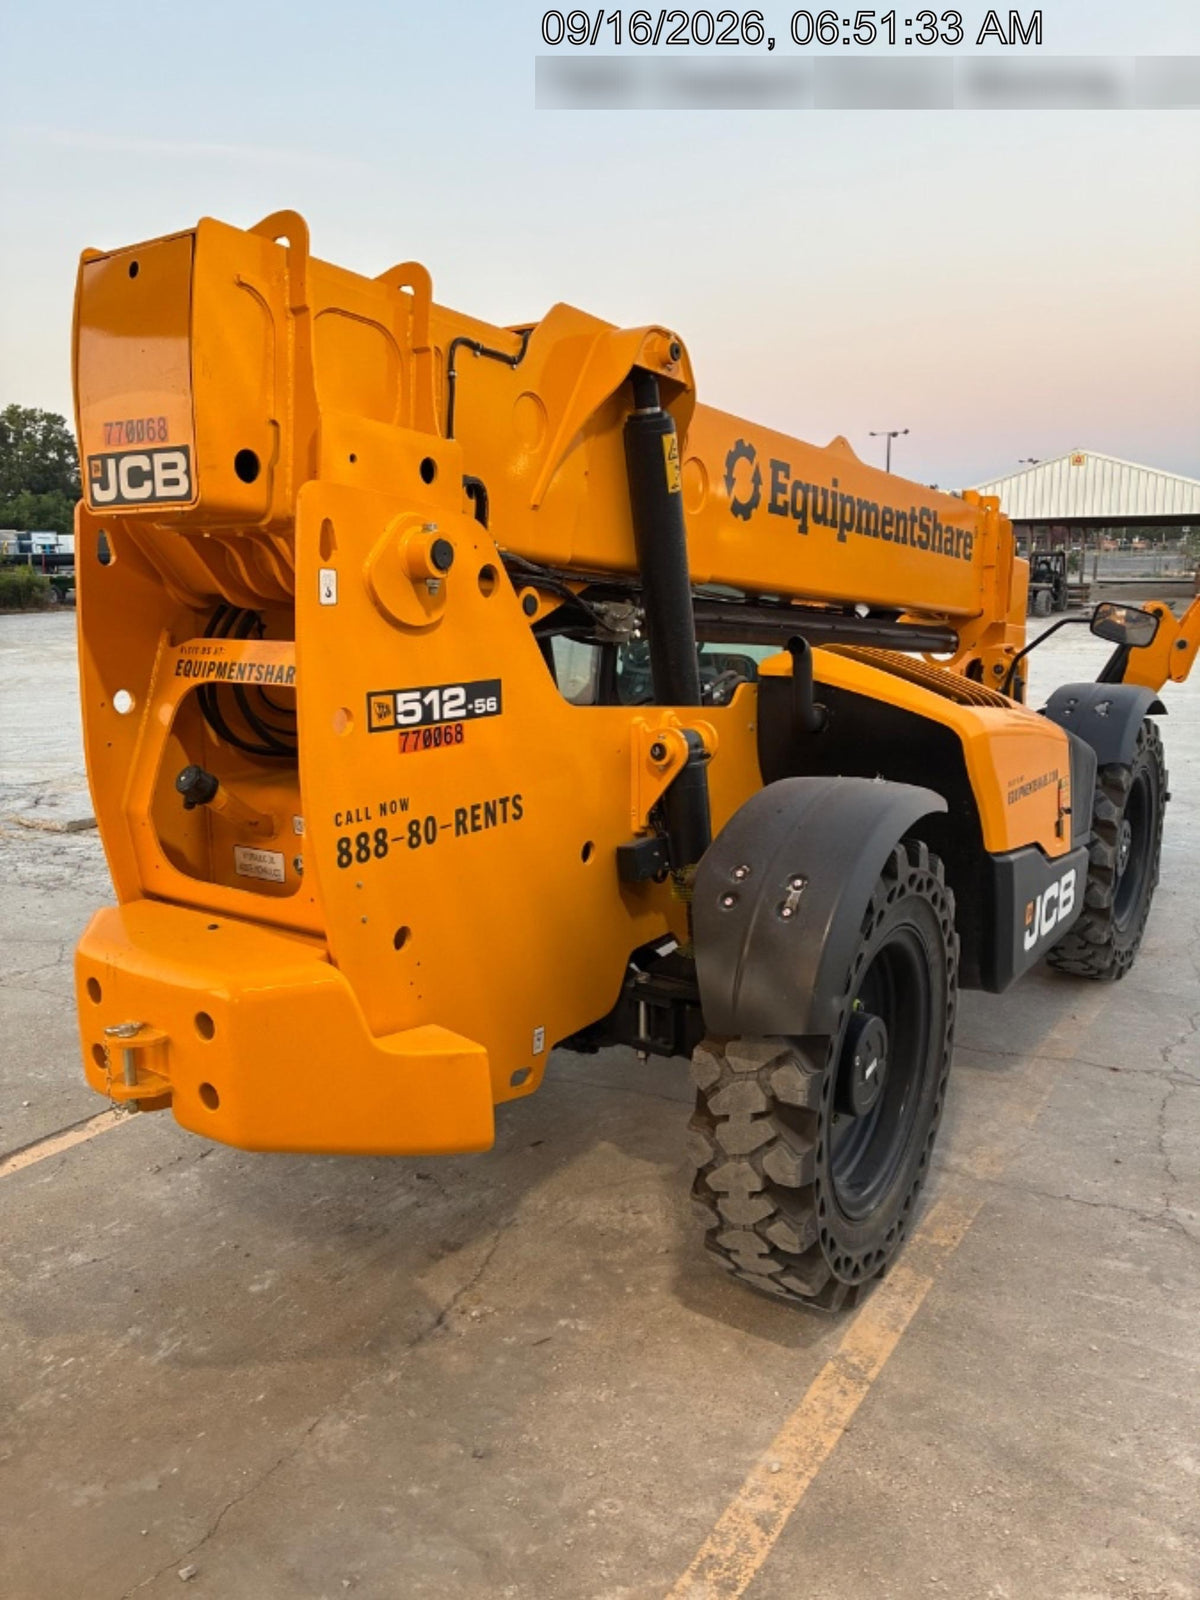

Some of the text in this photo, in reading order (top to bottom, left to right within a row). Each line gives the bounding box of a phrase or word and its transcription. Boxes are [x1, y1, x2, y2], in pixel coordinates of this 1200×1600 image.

[104, 417, 167, 445] 770068
[92, 451, 189, 502] JCB
[768, 458, 974, 561] EquipmentShare
[396, 687, 497, 724] 512-56
[400, 723, 463, 753] 770068
[334, 798, 410, 827] CALL NOW
[336, 794, 524, 869] 888-80-RENTS
[1024, 868, 1076, 952] JCB
